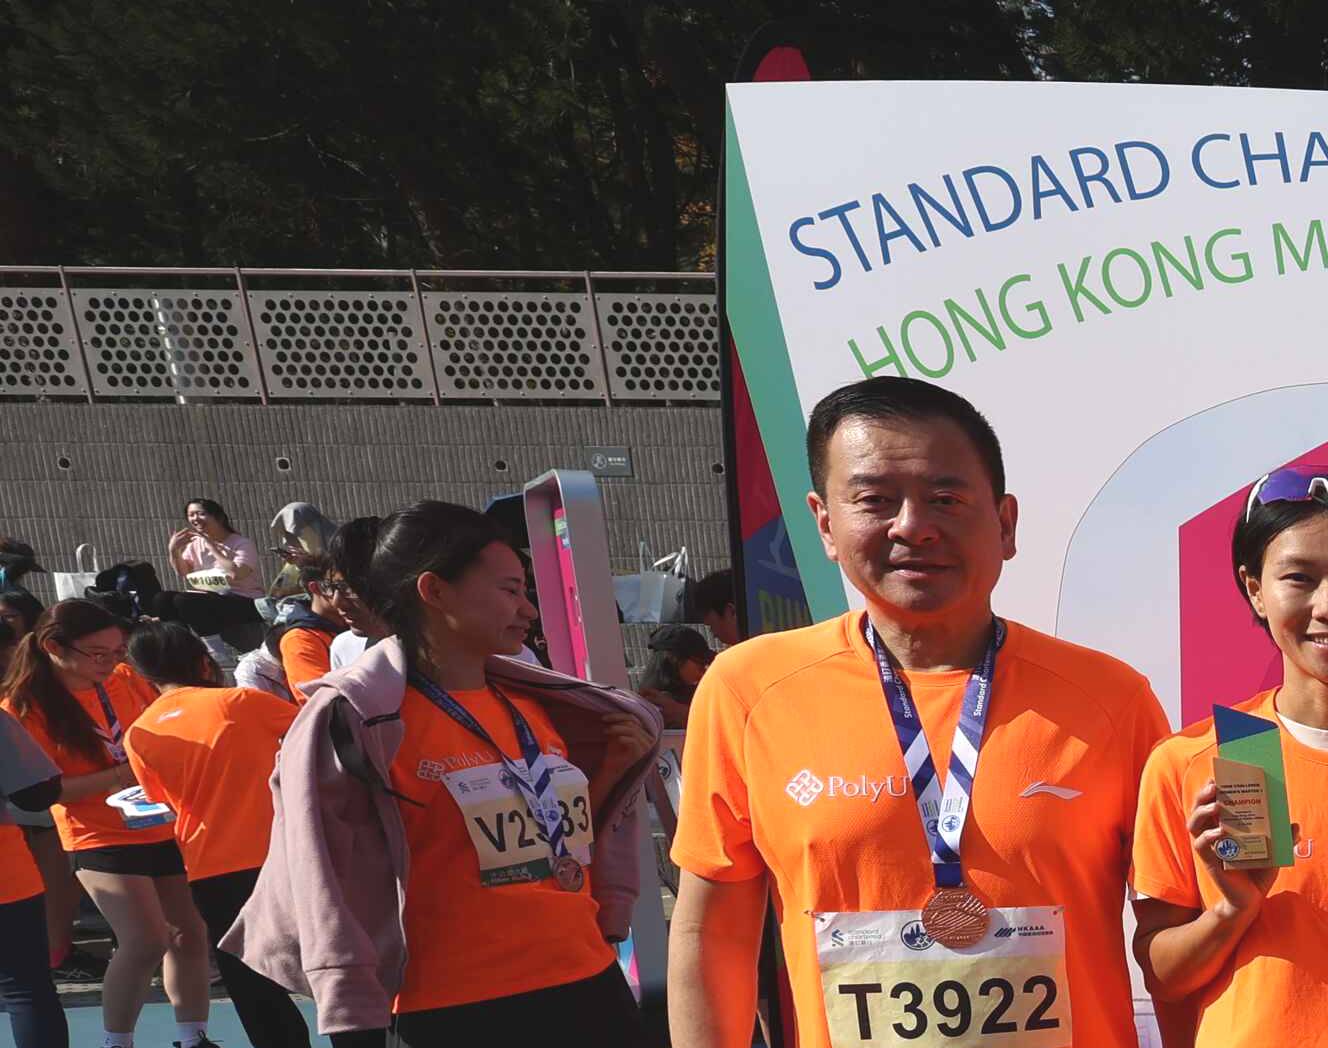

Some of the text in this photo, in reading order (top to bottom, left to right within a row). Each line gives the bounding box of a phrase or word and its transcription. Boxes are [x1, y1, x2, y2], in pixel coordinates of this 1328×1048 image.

[788, 140, 1171, 291] STANDARD
[847, 273, 1053, 379] HONG
[1056, 227, 1254, 323] KONG
[826, 775, 911, 804] PolyU
[474, 795, 592, 852] V283
[838, 975, 1060, 1041] T3922
